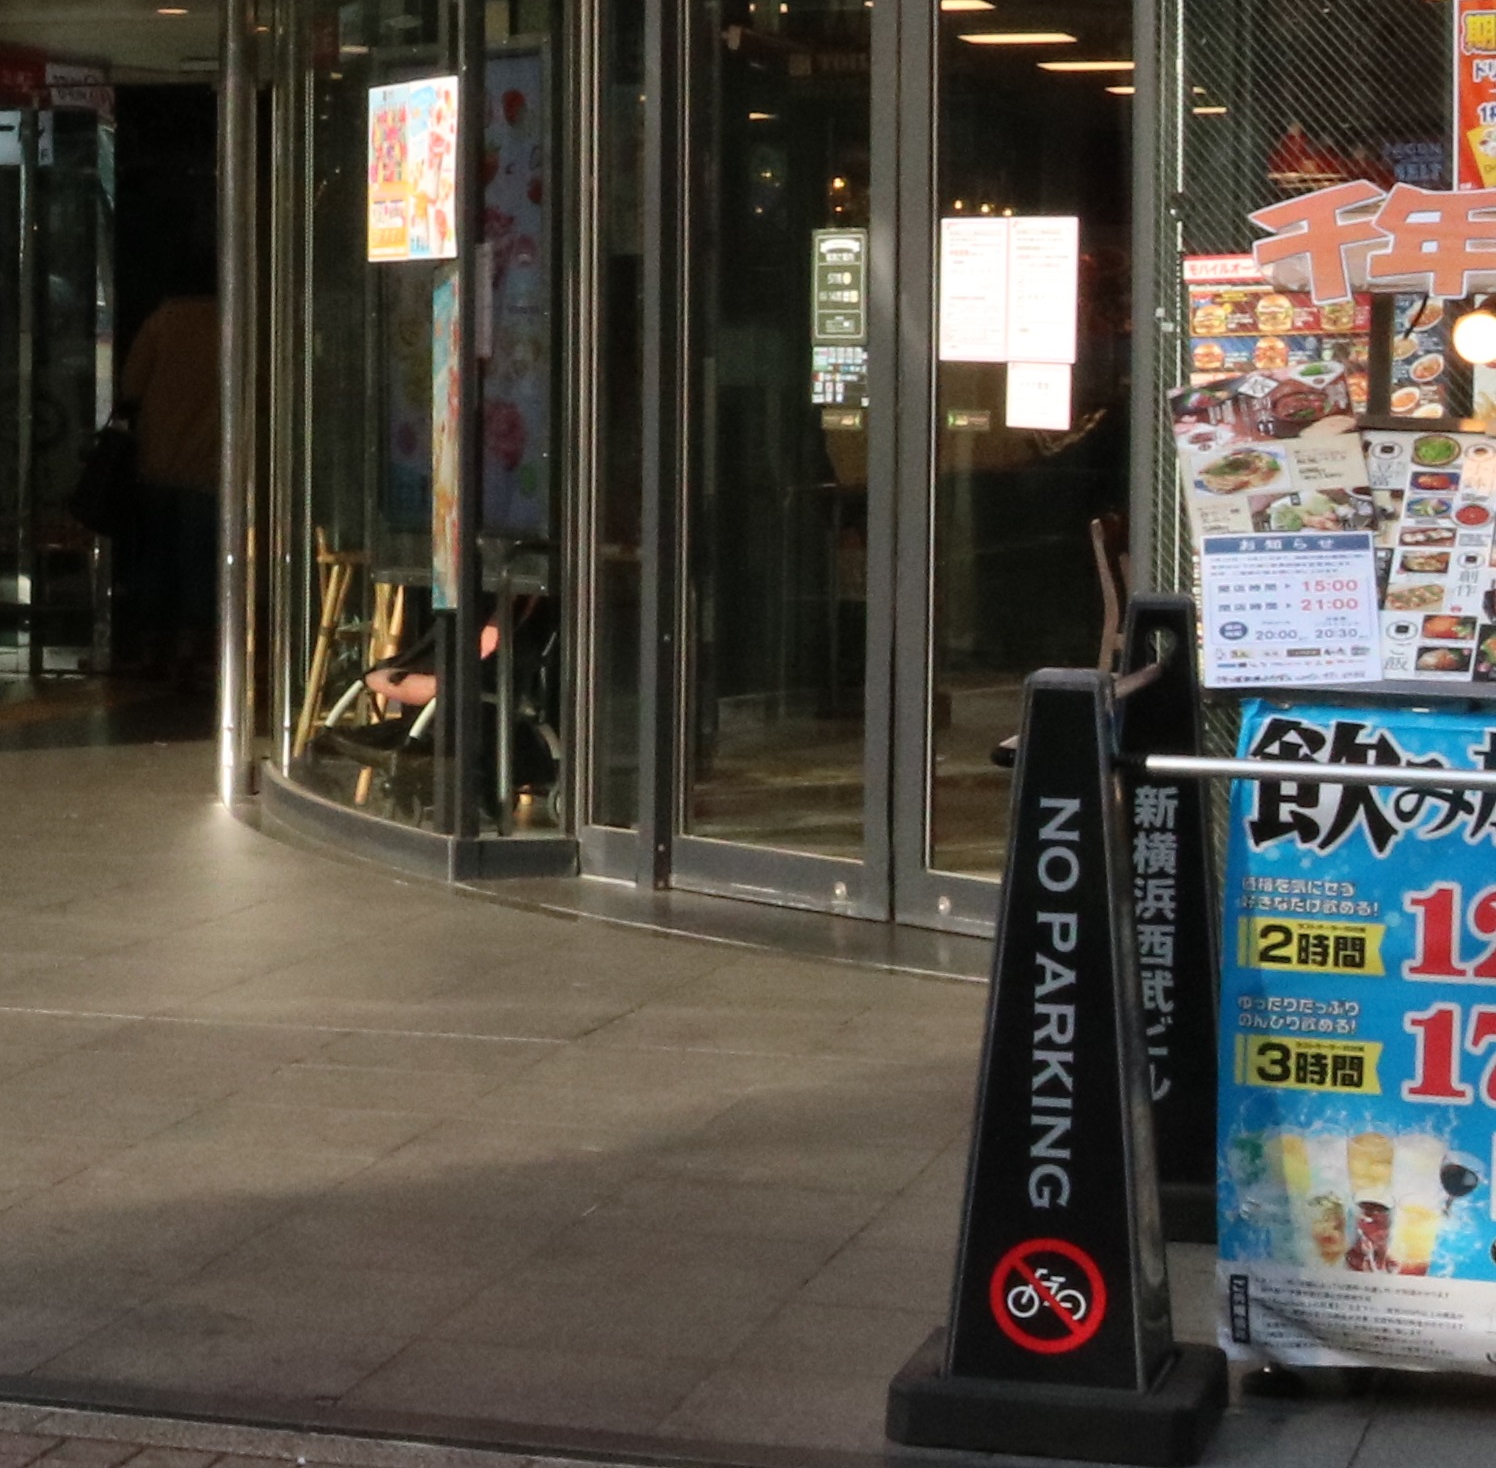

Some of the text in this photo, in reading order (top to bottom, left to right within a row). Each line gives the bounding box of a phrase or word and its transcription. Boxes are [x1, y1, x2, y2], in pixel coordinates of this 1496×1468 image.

[1239, 539, 1335, 551] お知らせ
[1302, 580, 1358, 592] 15:00
[1301, 598, 1359, 611] 21:00
[1256, 630, 1297, 641] 20:00
[1315, 628, 1358, 640] 20:30
[1260, 923, 1366, 968] 2時間
[1028, 798, 1080, 1209] NO PARKING
[1257, 1042, 1364, 1088] 3時間
